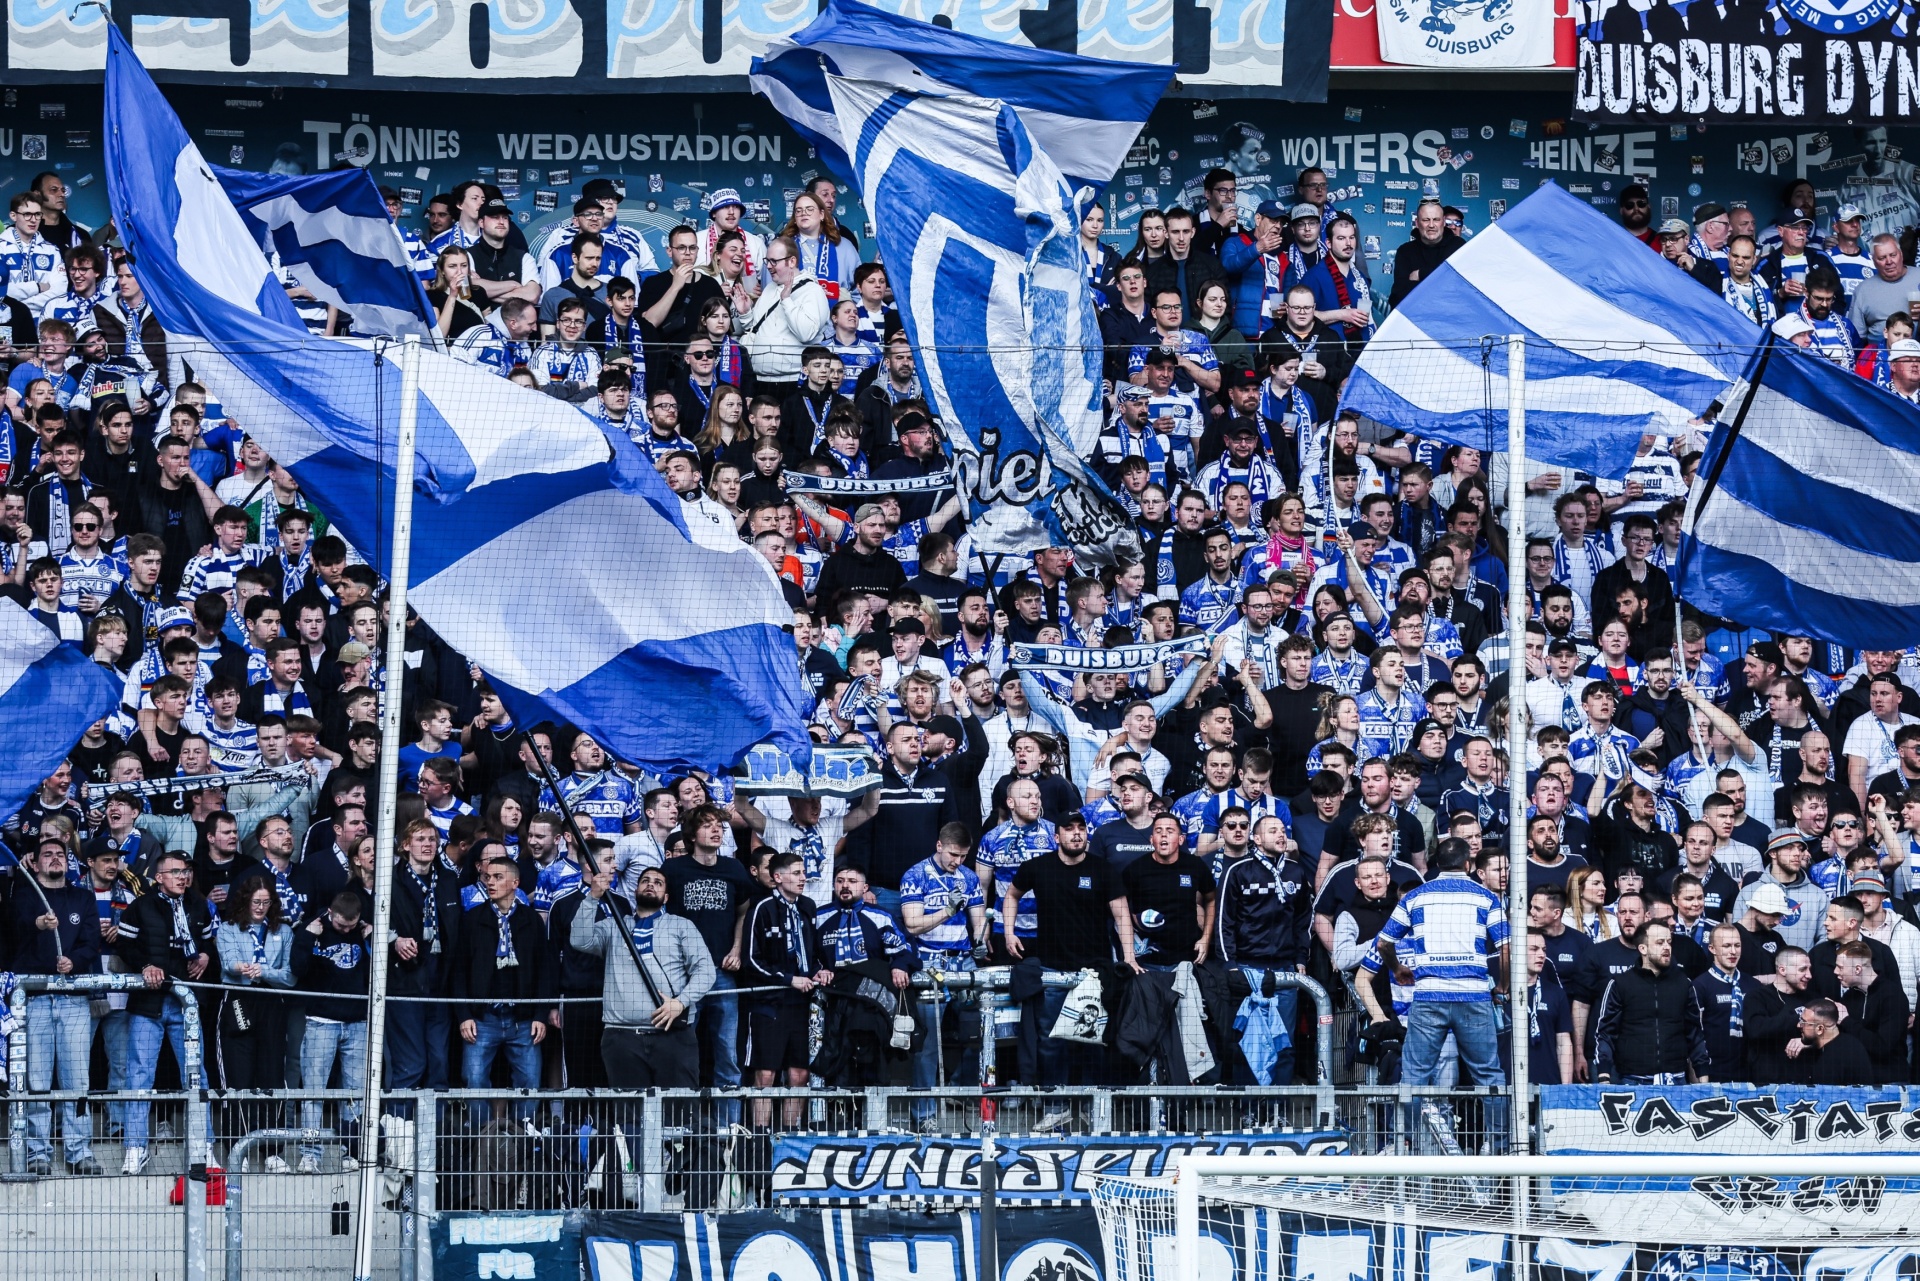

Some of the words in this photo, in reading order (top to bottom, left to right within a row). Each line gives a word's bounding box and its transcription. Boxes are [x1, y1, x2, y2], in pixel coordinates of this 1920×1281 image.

[1425, 22, 1515, 55] DUISBURG
[1577, 37, 1805, 117] DUISBURG
[303, 113, 461, 170] TÖNNIES
[497, 133, 782, 162] WEDAUSTADION
[1281, 130, 1447, 176] WOLTERS
[1530, 131, 1657, 178] HEINZE
[1737, 132, 1833, 180] HOPP
[821, 475, 946, 491] DUISBURG
[1046, 644, 1175, 669] DUISBURG
[221, 751, 246, 763] XTIP
[1690, 1174, 1887, 1216] CREW
[449, 1216, 564, 1245] FREIHEIT
[478, 1248, 536, 1280] FÜR
